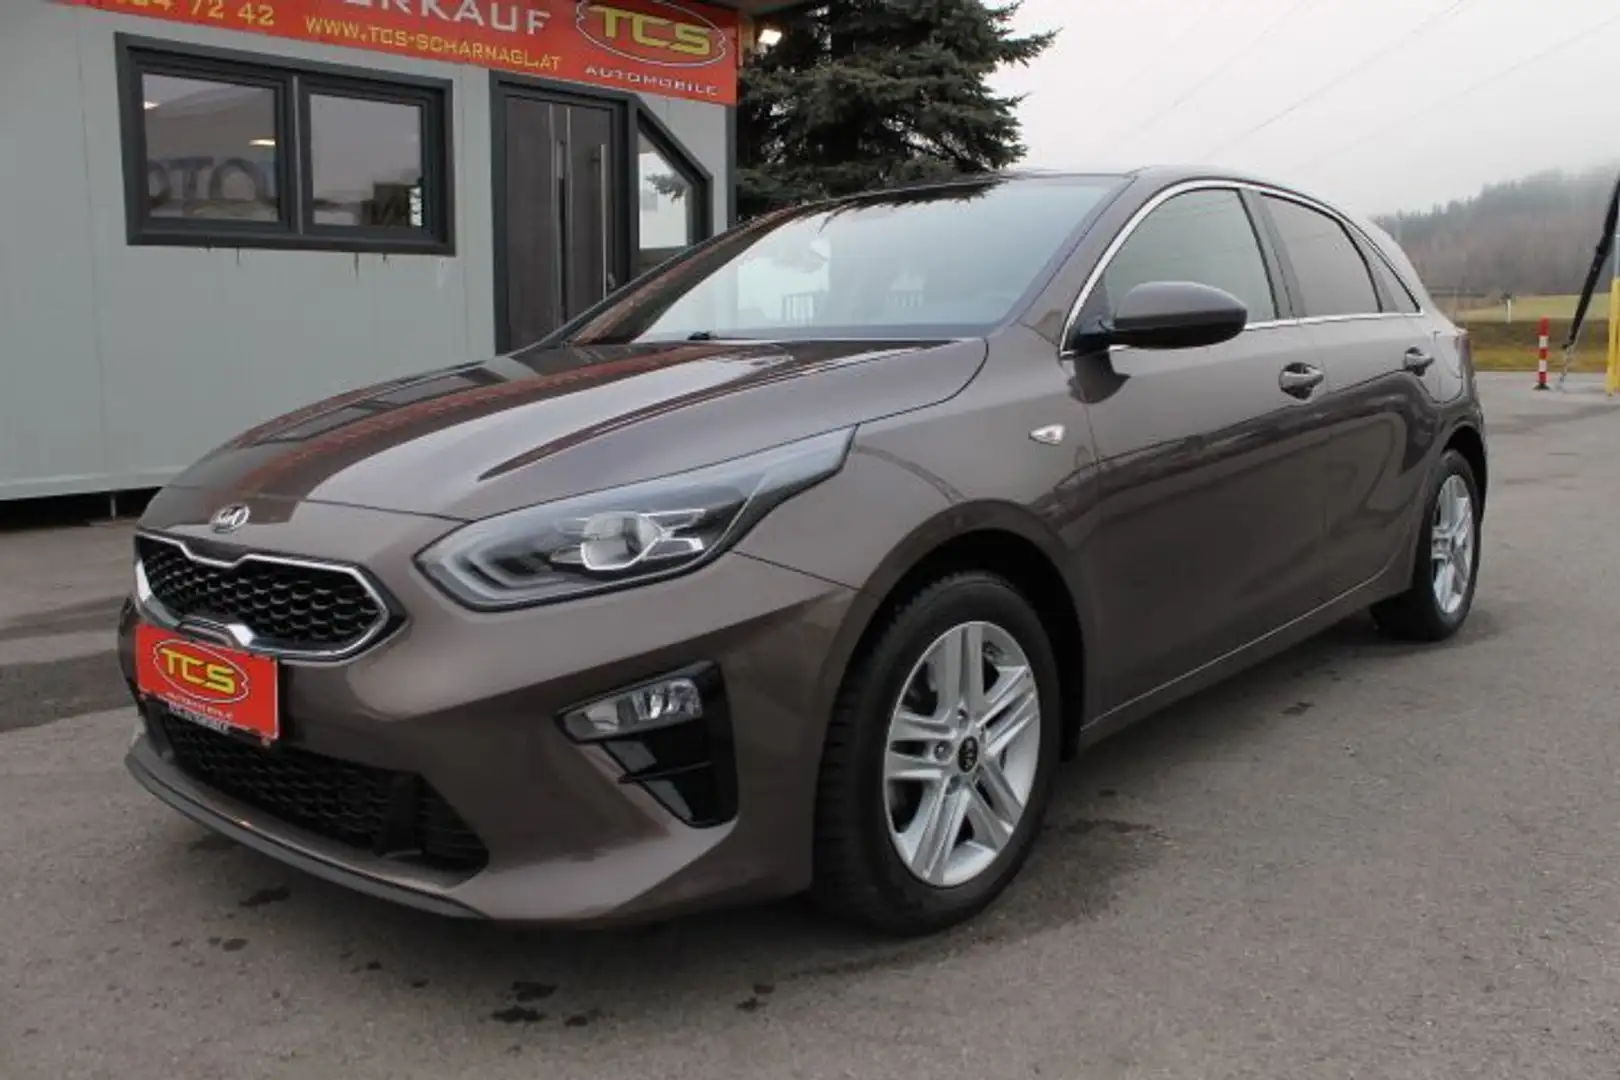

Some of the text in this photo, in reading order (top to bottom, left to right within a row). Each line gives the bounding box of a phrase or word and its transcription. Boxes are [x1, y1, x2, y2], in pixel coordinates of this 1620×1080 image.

[237, 2, 275, 27] 42
[588, 5, 711, 55] TCS
[585, 65, 718, 96] AUTOMOBILE
[160, 648, 235, 694] TCS
